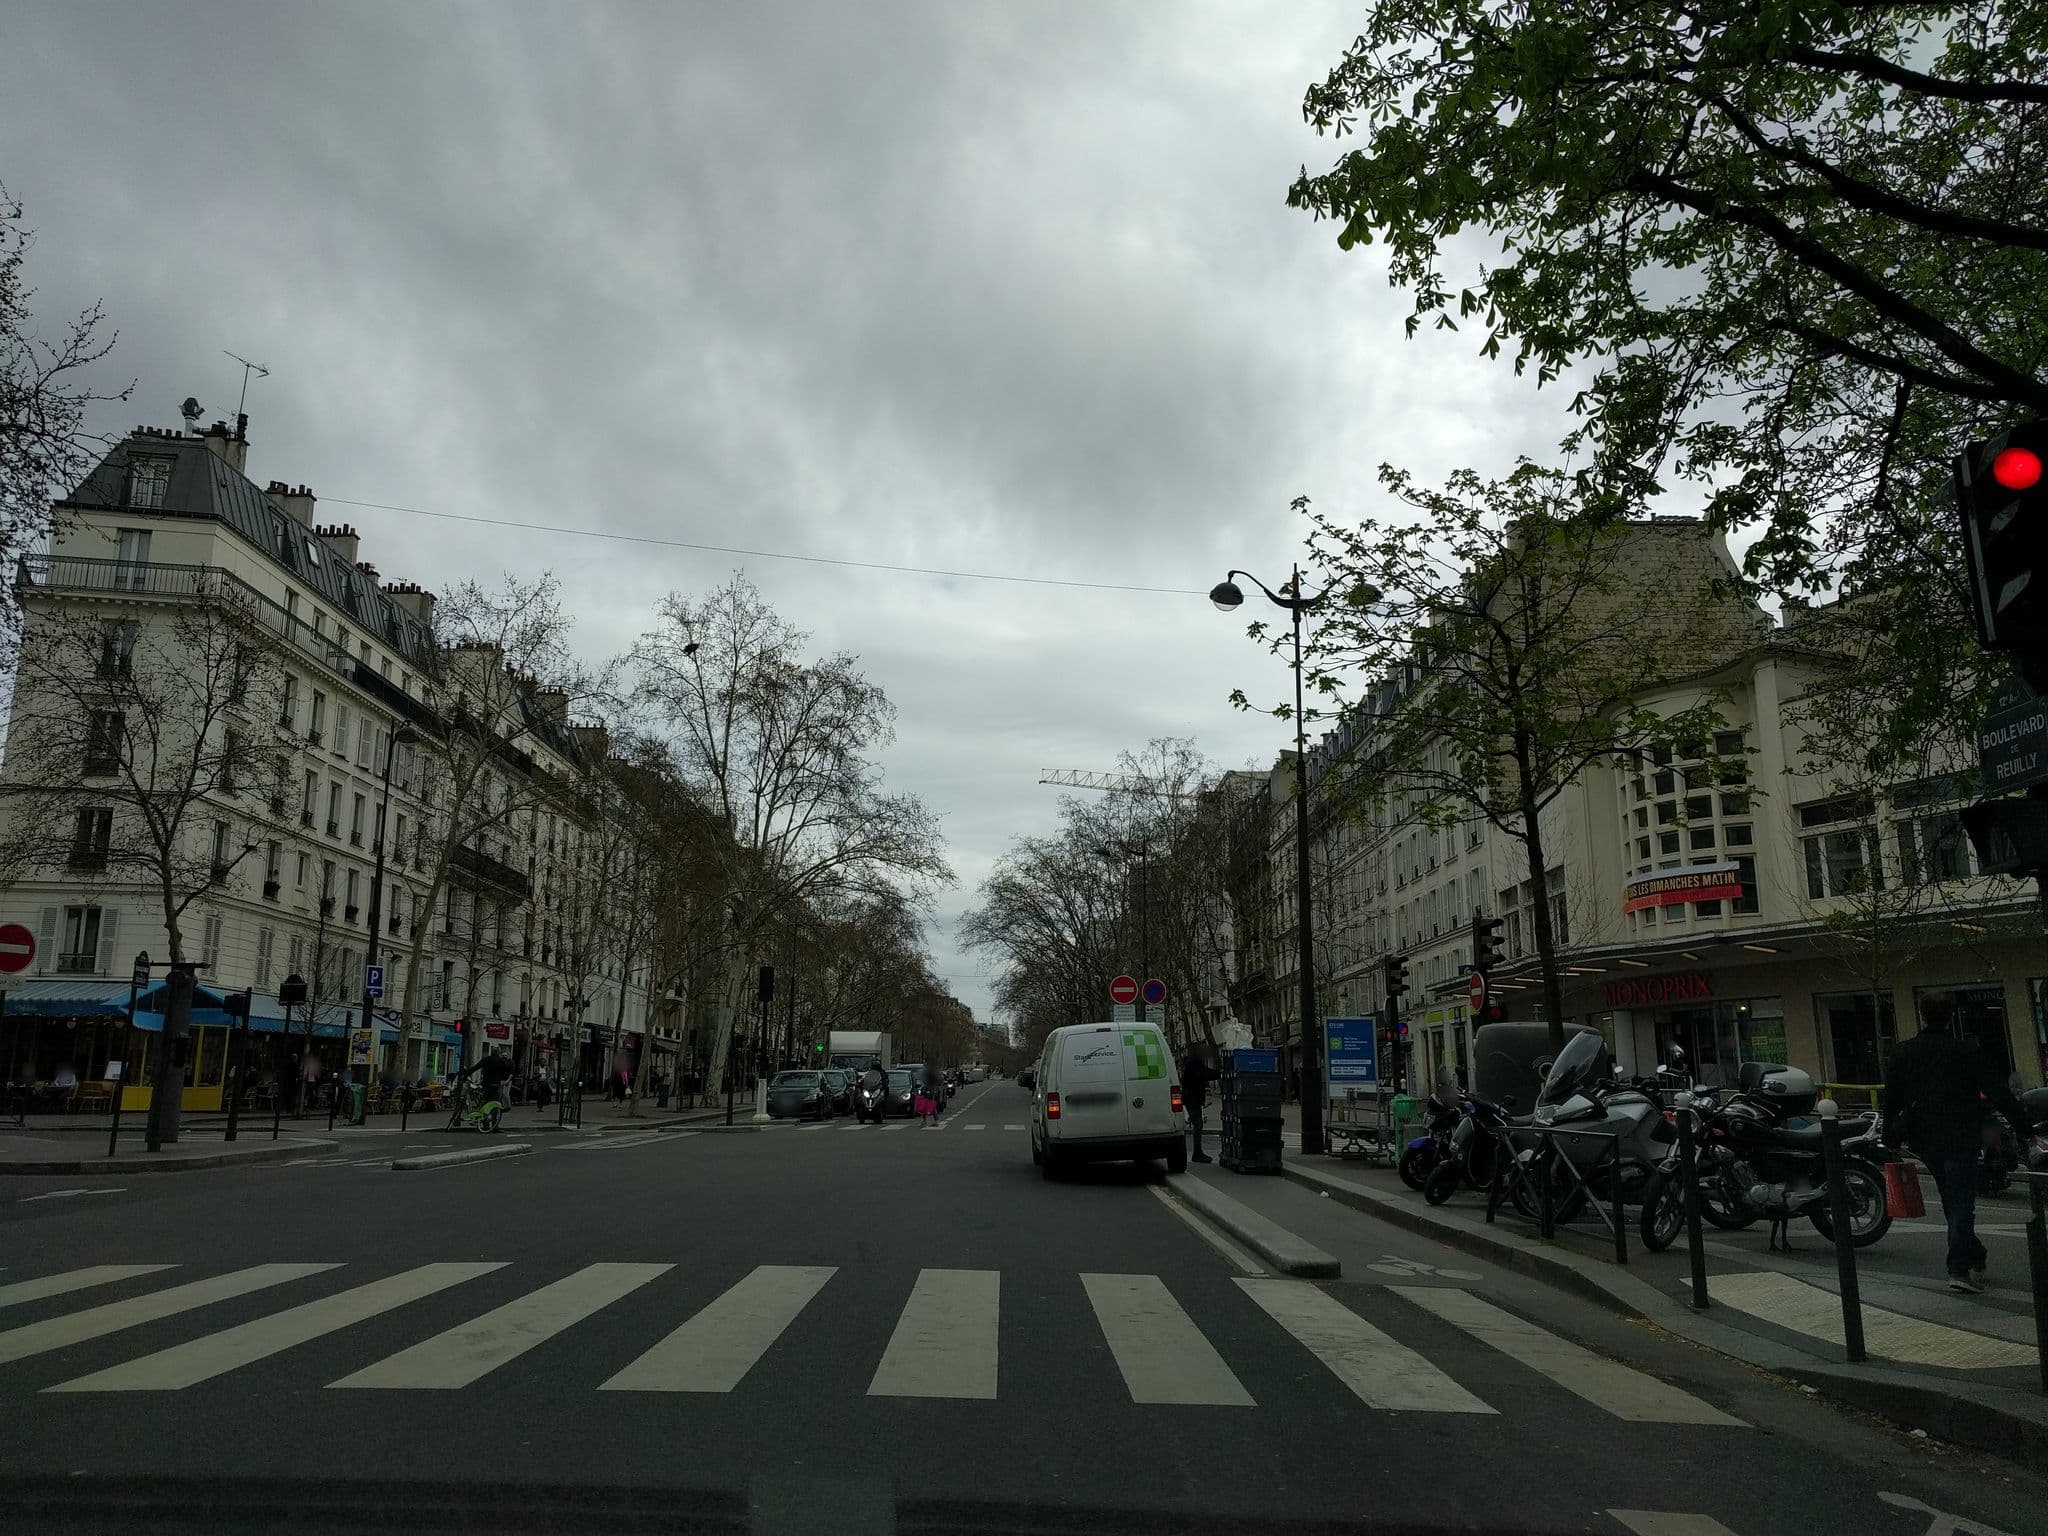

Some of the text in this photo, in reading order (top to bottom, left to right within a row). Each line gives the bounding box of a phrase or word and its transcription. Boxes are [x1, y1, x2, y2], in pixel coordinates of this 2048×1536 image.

[1983, 714, 2044, 749] BOULEVARD
[2010, 743, 2020, 754] DE
[1996, 752, 2037, 780] REUILLY
[1638, 882, 1649, 896] LES
[1649, 875, 1700, 892] DIMANCHES
[1702, 871, 1736, 887] MATIN
[371, 970, 379, 983] P
[1603, 975, 1713, 1007] MONOPRIX
